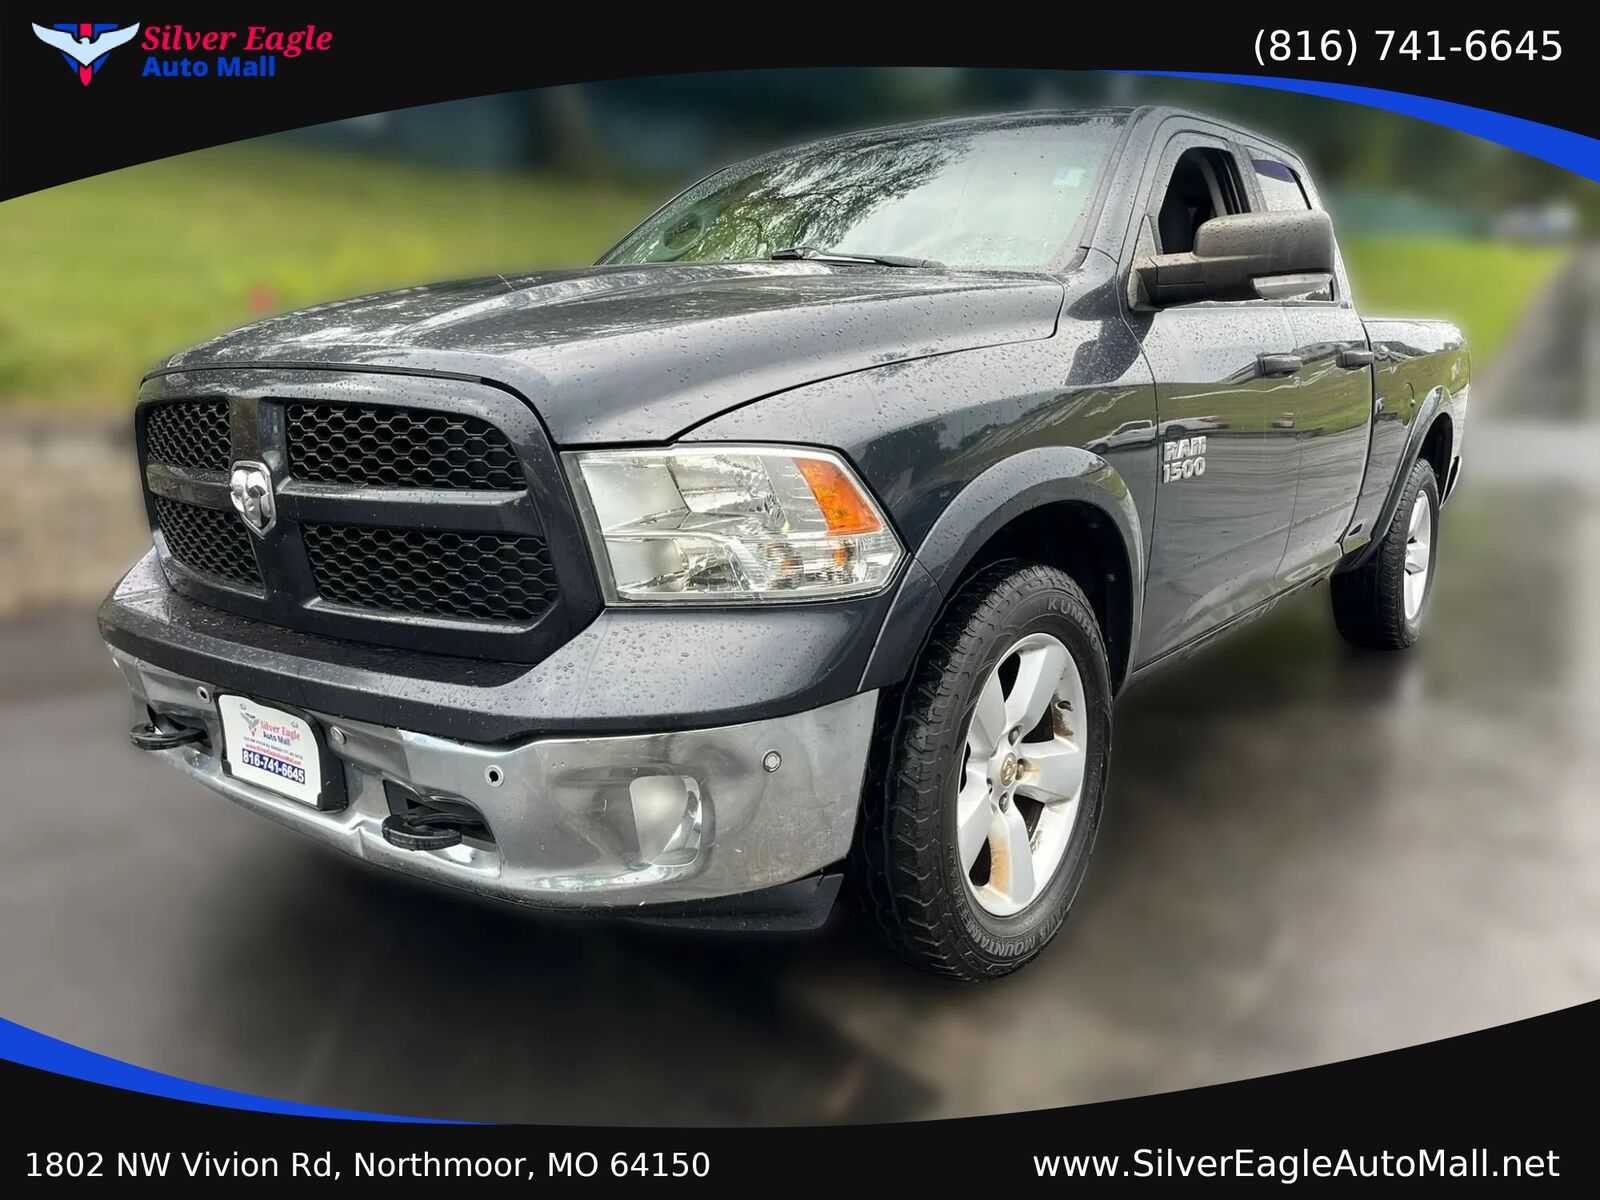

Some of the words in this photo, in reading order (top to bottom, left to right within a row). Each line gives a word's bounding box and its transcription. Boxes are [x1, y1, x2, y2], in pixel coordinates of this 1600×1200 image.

[1163, 435, 1207, 462] RAM
[1163, 456, 1206, 484] 1500
[243, 750, 305, 783] 816-741-6645
